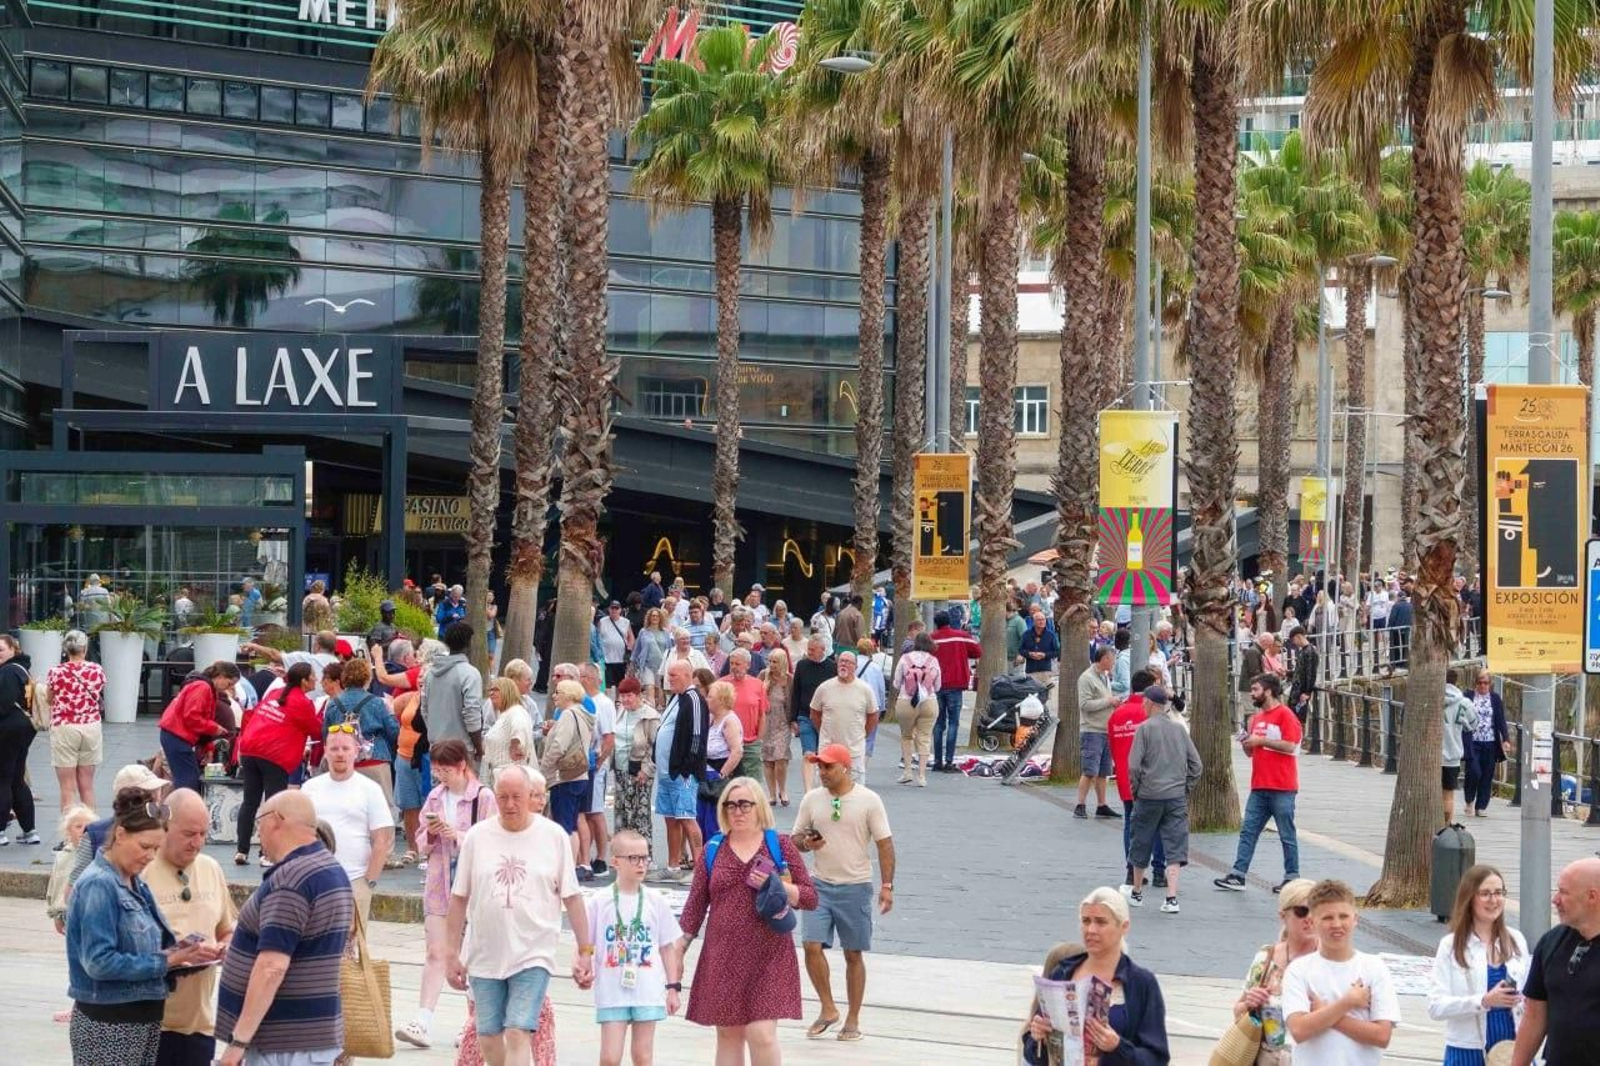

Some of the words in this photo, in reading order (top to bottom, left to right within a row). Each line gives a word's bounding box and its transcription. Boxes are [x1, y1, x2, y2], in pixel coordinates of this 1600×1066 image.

[174, 346, 211, 404] A
[235, 346, 378, 407] LAXE
[440, 517, 471, 532] VIGO
[1495, 590, 1579, 605] EXPOSICIÓN
